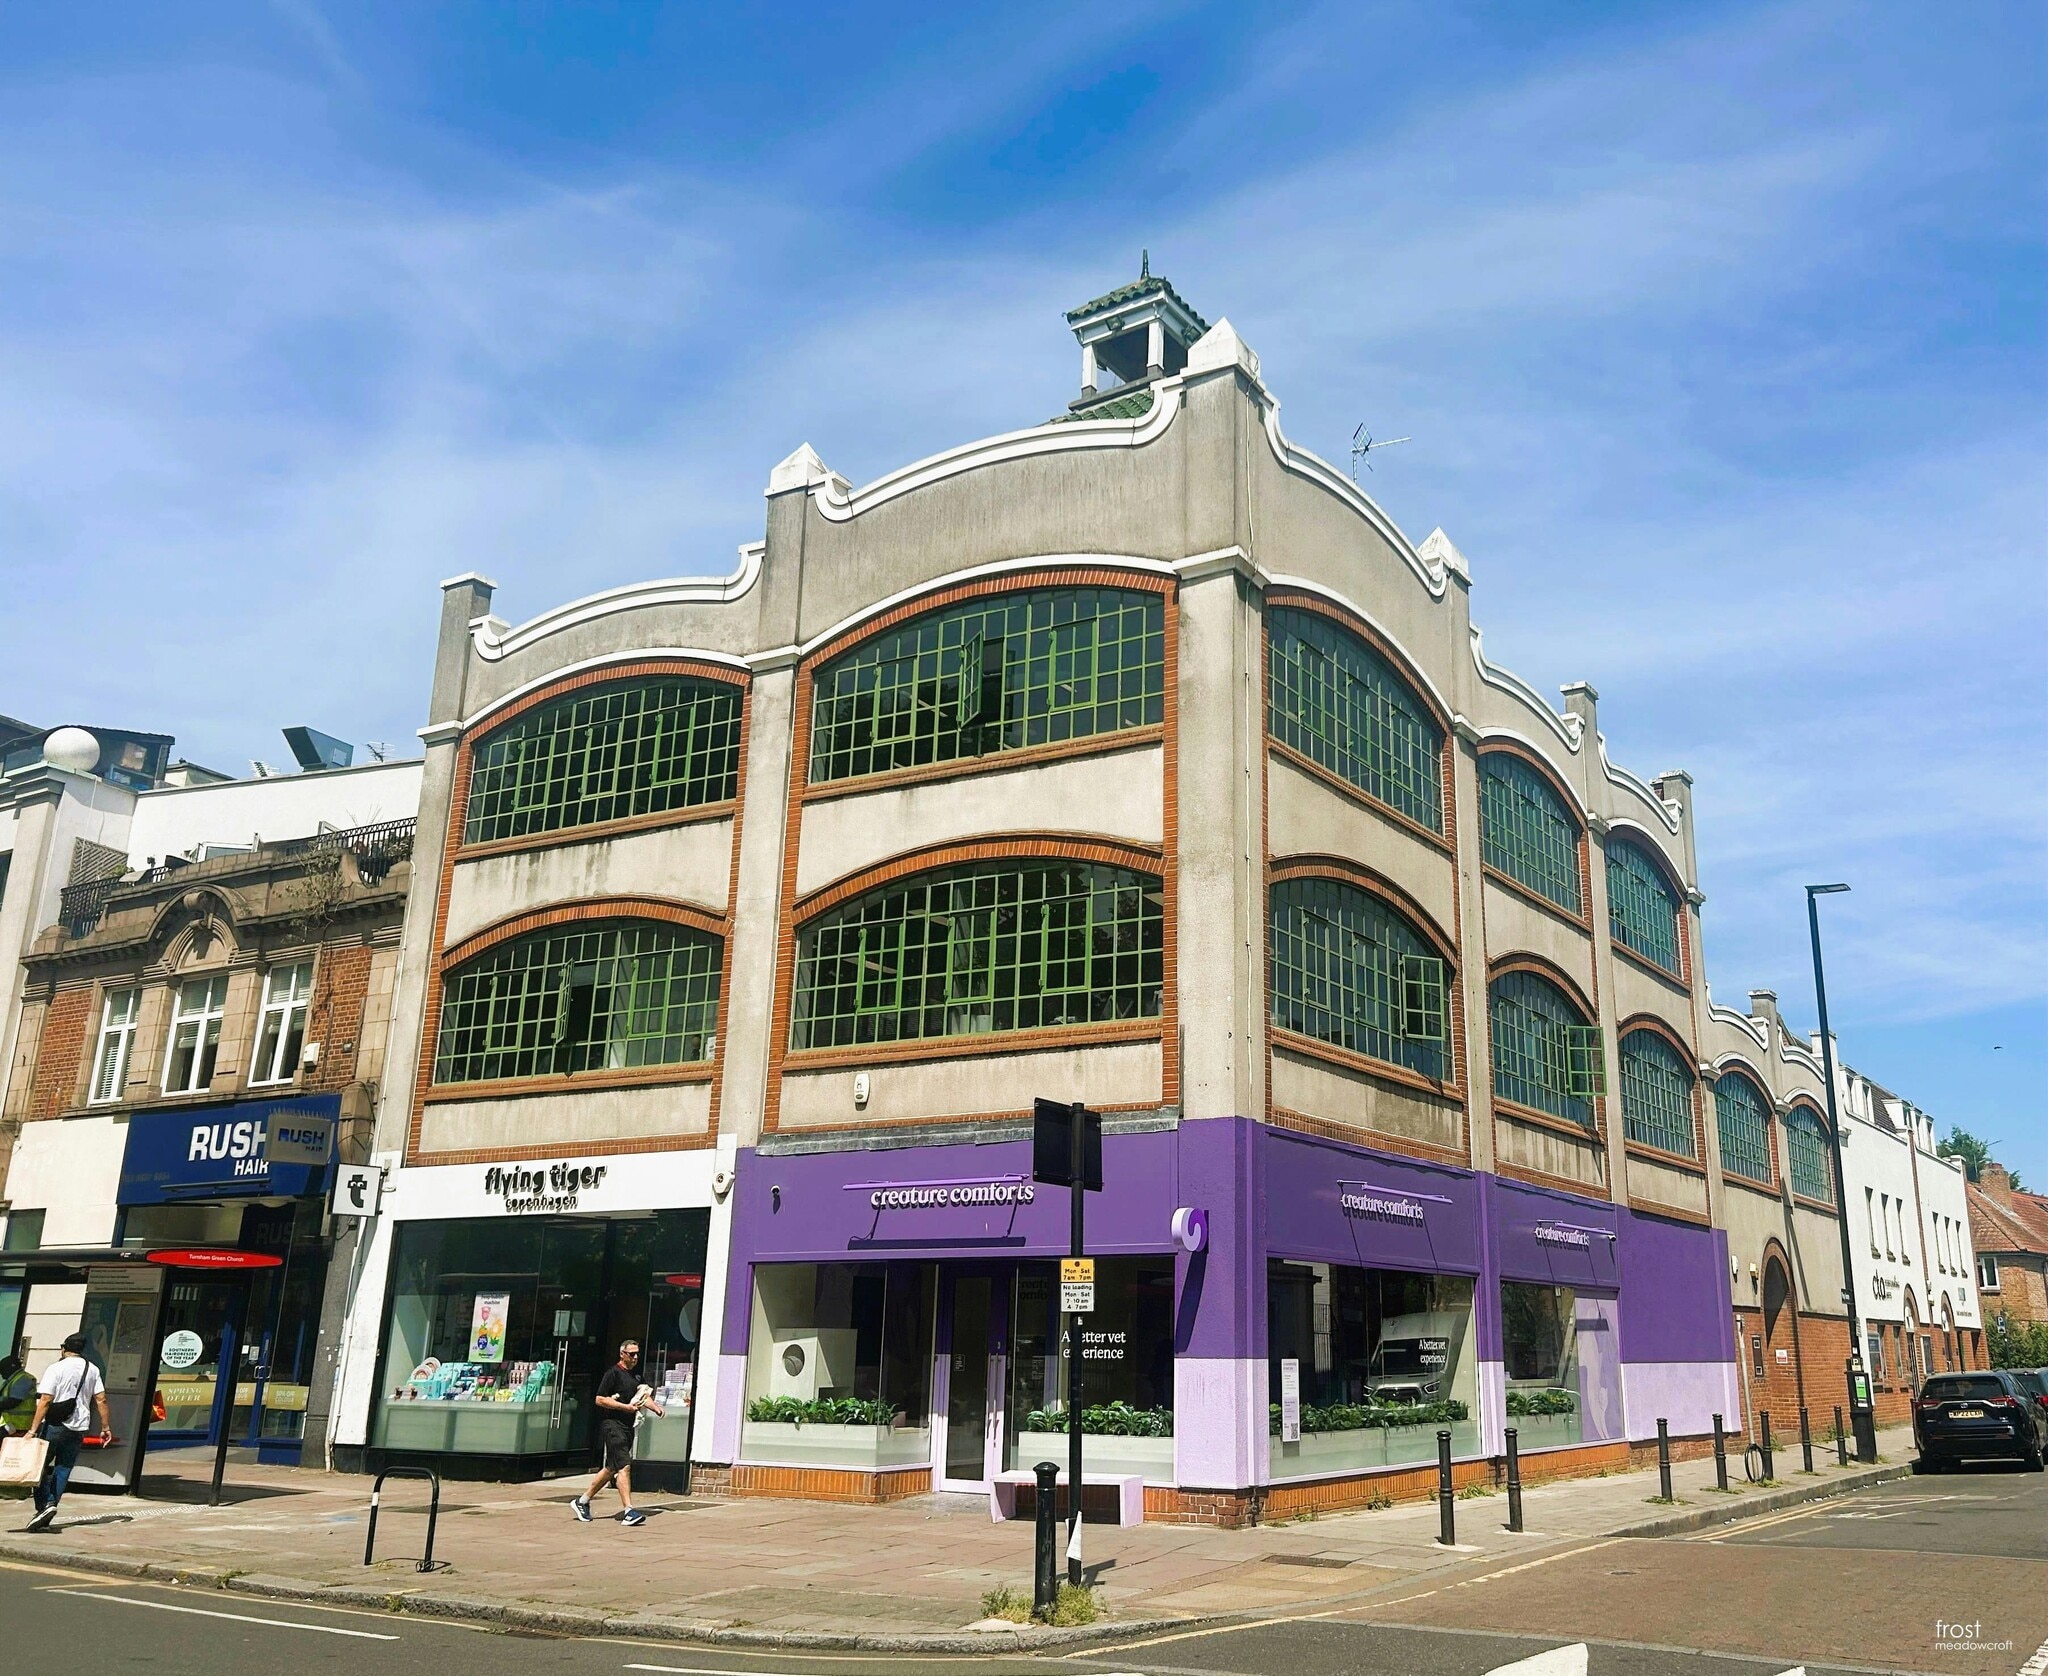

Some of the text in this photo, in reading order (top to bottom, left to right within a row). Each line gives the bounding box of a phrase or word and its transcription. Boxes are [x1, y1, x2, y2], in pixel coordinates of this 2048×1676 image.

[278, 1128, 325, 1145] RUSH
[234, 1159, 269, 1176] HAIR
[485, 1162, 607, 1196] flying tiger
[870, 1182, 1035, 1206] creature comforts
[505, 1195, 577, 1210] copenhagen
[1341, 1193, 1424, 1220] creature comforts
[1534, 1226, 1590, 1247] creature comforts
[1998, 1316, 2004, 1326] P
[1061, 1329, 1127, 1343] A etter vet
[1419, 1338, 1424, 1350] A
[1423, 1338, 1438, 1350] better
[1063, 1345, 1125, 1359] eerience
[1420, 1352, 1446, 1366] experience
